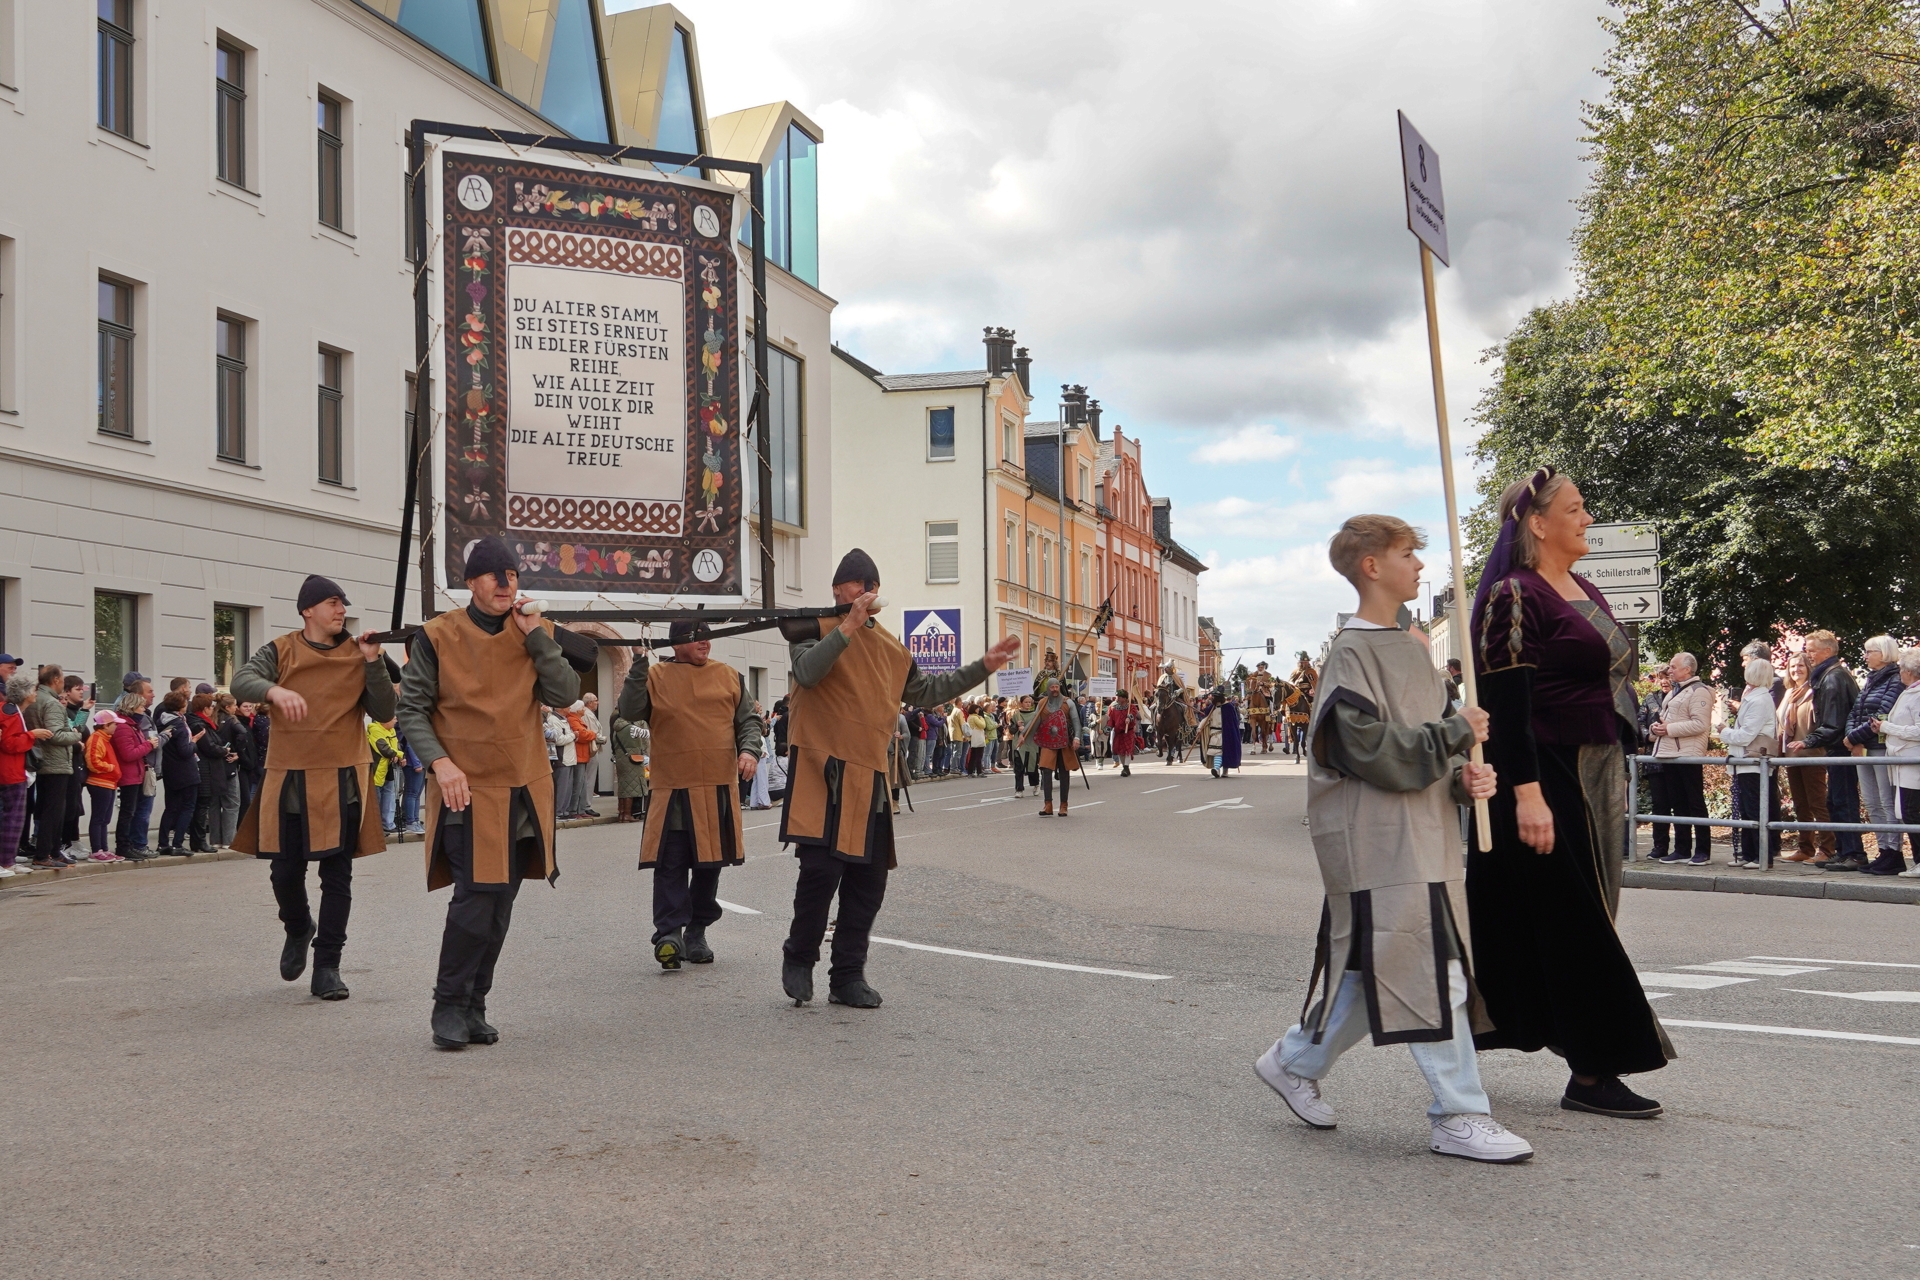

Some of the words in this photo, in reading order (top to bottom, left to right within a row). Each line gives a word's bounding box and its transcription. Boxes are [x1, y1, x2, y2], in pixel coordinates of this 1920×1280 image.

[1418, 143, 1427, 183] 8
[513, 297, 537, 312] DU
[542, 300, 596, 317] ALTER
[516, 317, 543, 332] SEI
[547, 319, 599, 336] STETS
[603, 323, 668, 342] ERNEUT
[514, 335, 533, 350] IN
[538, 337, 589, 354] EDLER
[594, 339, 669, 361] FÜRSTEN
[569, 358, 621, 377] REIHE,
[532, 374, 565, 390] WIE
[570, 377, 611, 393] ALLE
[616, 380, 655, 396] ZEIT
[534, 393, 573, 409] DEIN
[578, 396, 622, 413] VOLK
[627, 400, 654, 415] DIR
[567, 414, 621, 431] WEIHT
[511, 429, 538, 444] DIE
[542, 432, 586, 447] ALTE
[590, 434, 674, 452] DEUTSCHE
[566, 451, 623, 467] TREUE.
[1585, 535, 1604, 547] ing
[1596, 566, 1651, 578] Schillerstraße
